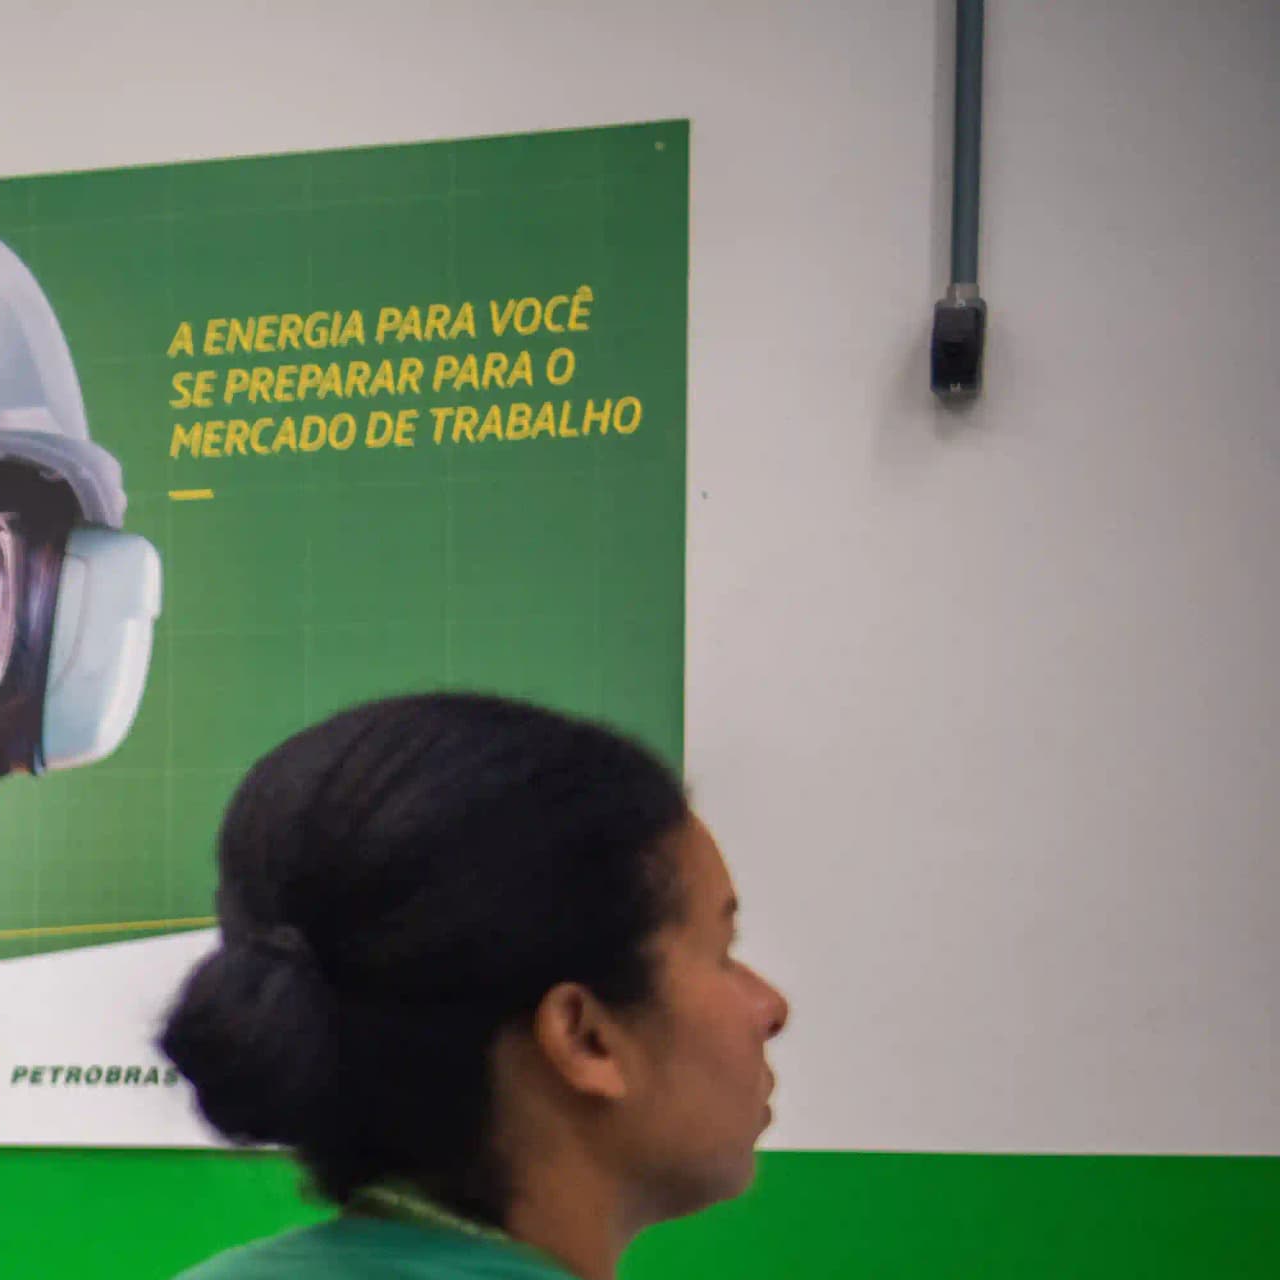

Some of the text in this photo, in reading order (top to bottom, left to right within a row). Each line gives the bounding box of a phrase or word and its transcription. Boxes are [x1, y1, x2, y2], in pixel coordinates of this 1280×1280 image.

[167, 285, 593, 358] A ENERGIA PARA VOCÊ
[169, 347, 575, 409] SE PREPARAR PARA O
[169, 396, 642, 459] MERCADO DE TRABALHO
[11, 1064, 178, 1088] PETROBRAS
